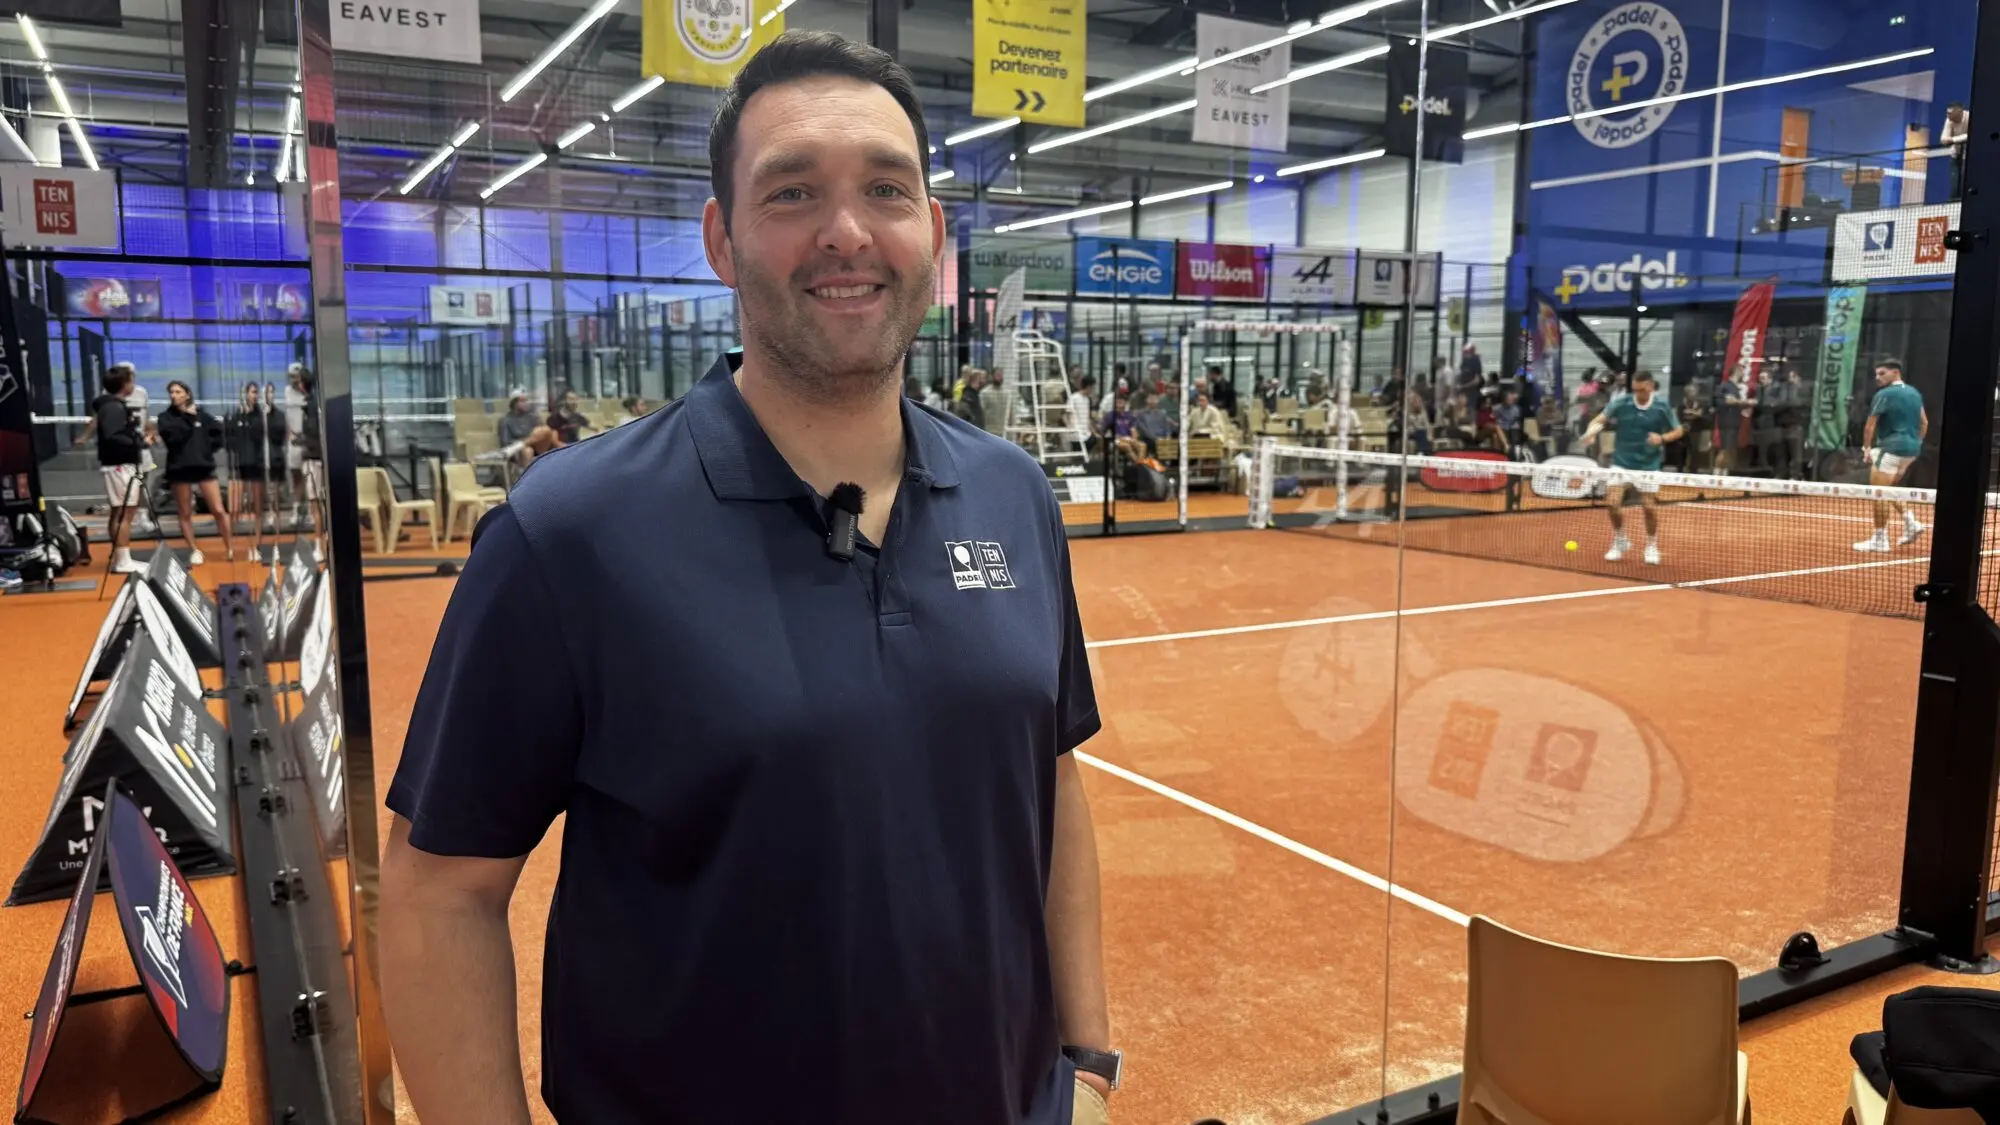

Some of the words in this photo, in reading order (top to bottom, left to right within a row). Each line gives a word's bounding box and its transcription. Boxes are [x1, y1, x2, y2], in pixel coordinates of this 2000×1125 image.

[341, 2, 446, 28] EAVEST
[999, 40, 1061, 61] Devenez
[991, 59, 1068, 79] partenaire
[1212, 108, 1269, 127] EAVEST
[39, 186, 69, 202] TEN
[42, 211, 71, 228] NIS
[1921, 221, 1945, 238] TEN
[1919, 244, 1942, 258] NIS
[974, 250, 1065, 272] waterdrop
[1189, 258, 1254, 282] Wilson
[1820, 296, 1855, 423] waterdrop
[981, 548, 1001, 562] TEN
[956, 574, 984, 583] PADEL
[990, 569, 1008, 582] NIS
